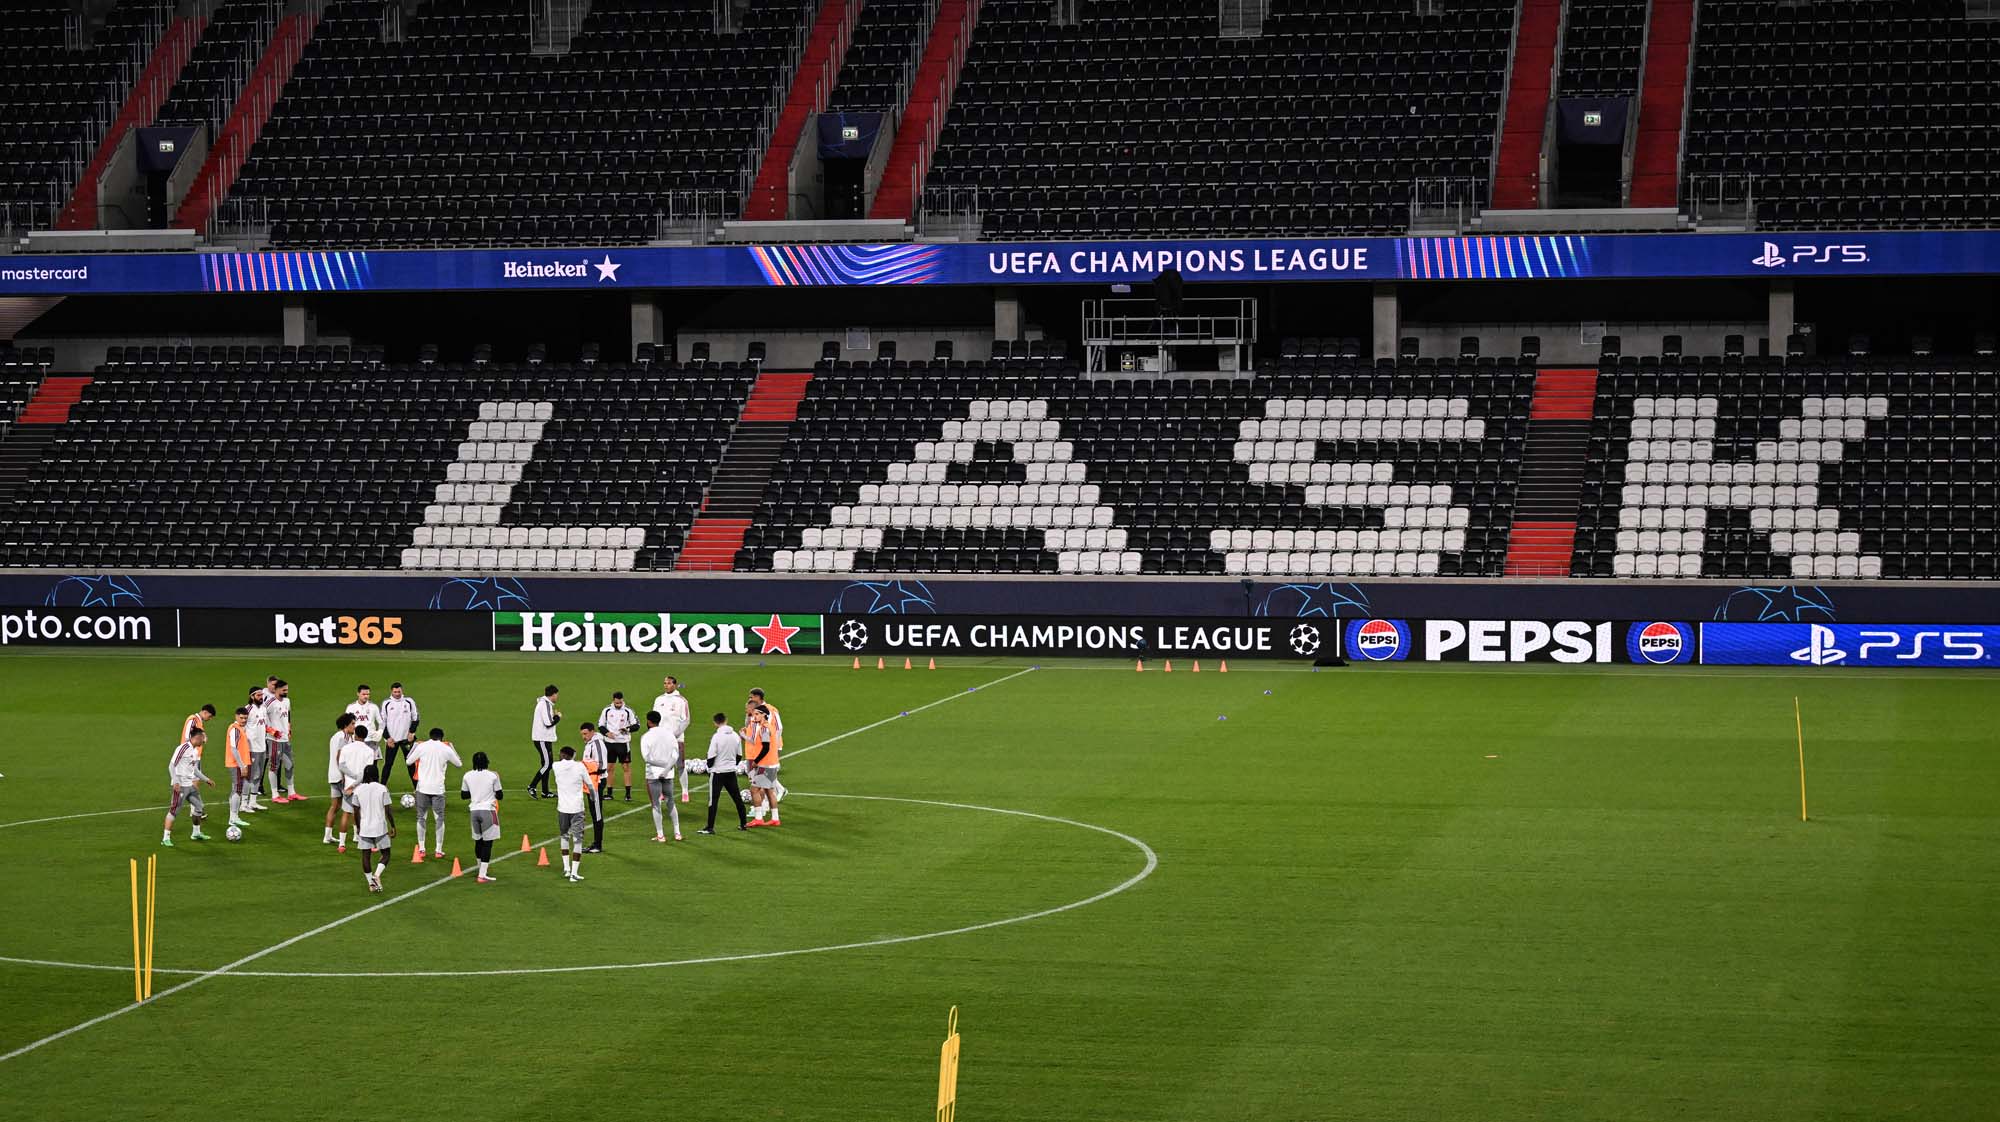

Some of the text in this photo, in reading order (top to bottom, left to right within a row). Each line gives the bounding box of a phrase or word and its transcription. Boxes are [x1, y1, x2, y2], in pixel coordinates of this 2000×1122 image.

[989, 247, 1368, 274] UEFA CHAMPIONS LEAGUE
[1792, 244, 1867, 263] PS5
[1, 265, 88, 280] mastercard
[504, 259, 588, 279] Heineken
[2, 608, 151, 644] pto.com
[275, 613, 403, 645] bet365
[520, 612, 749, 653] Heineken
[885, 623, 1272, 651] UEFA CHAMPIONS LEAGUE
[1360, 635, 1397, 645] PEPSI
[1424, 619, 1612, 664] PEPSI
[1641, 637, 1680, 647] PEPSI
[1858, 631, 1985, 660] PS5
